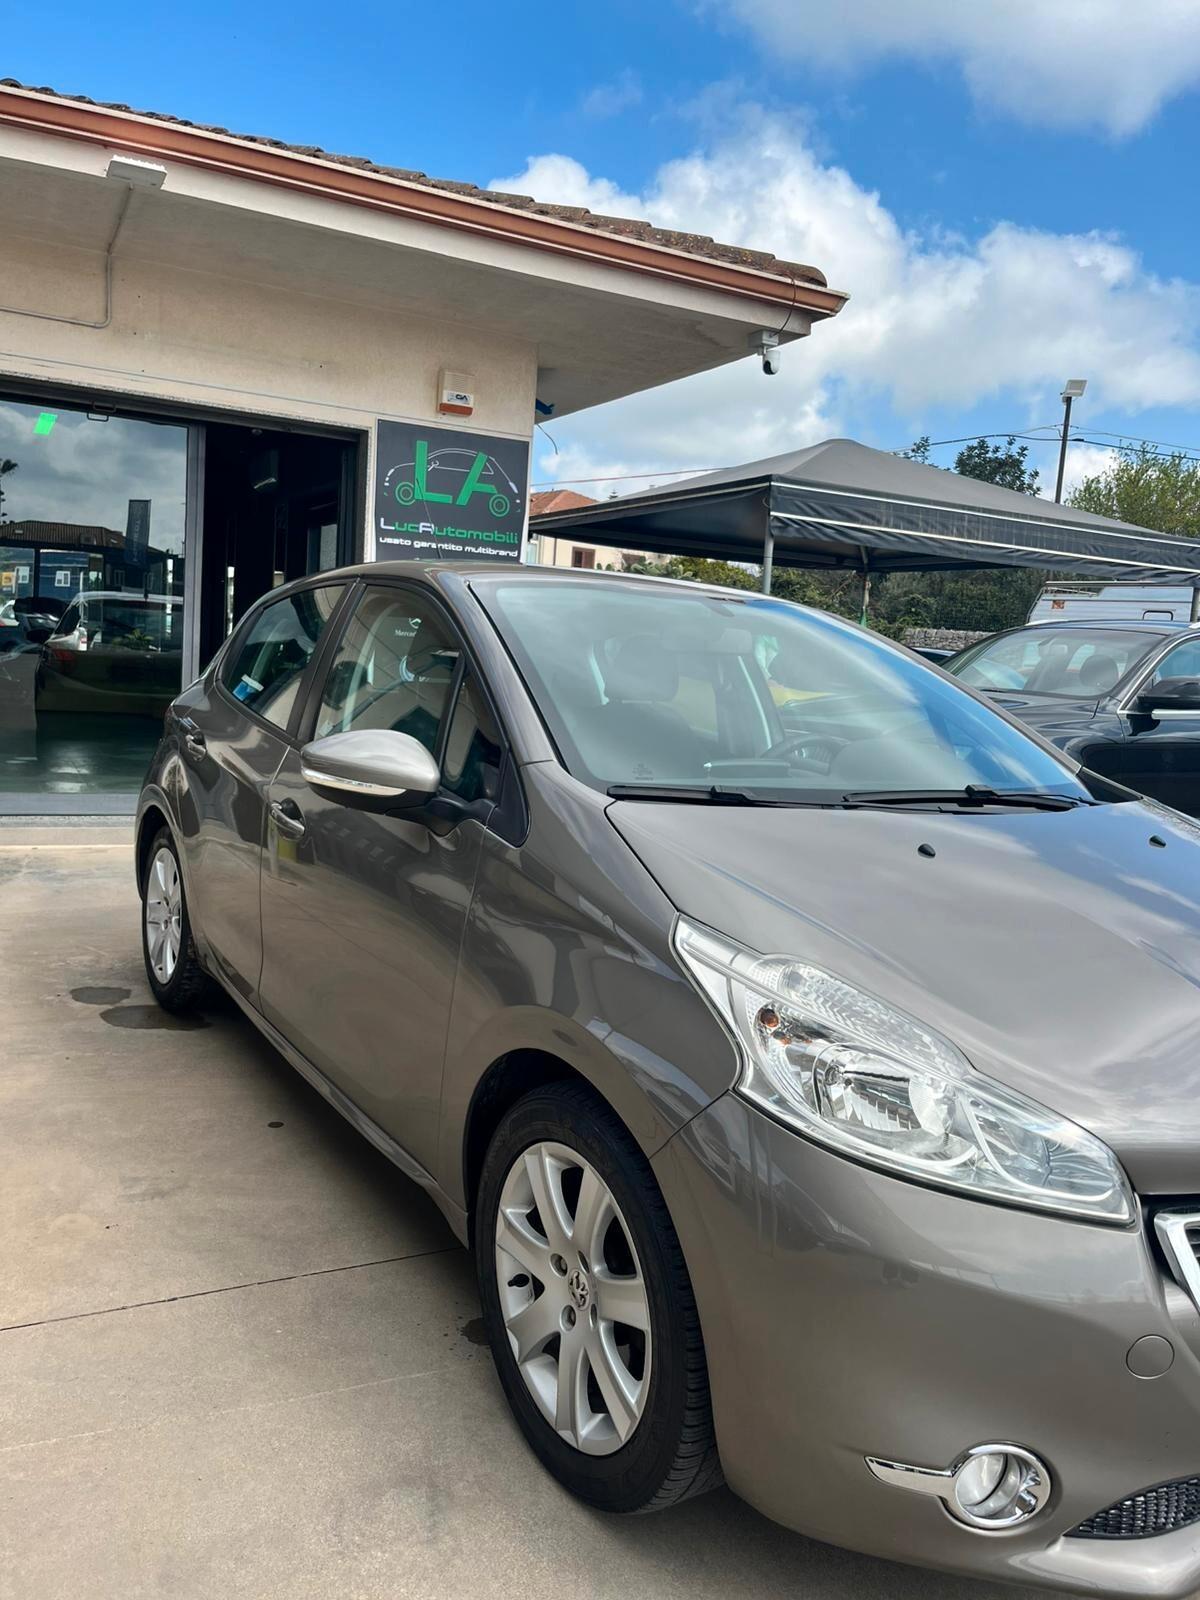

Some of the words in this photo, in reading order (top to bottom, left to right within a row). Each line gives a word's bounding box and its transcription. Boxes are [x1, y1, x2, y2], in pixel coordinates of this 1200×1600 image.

[380, 517, 518, 544] LucAutomobili
[379, 537, 412, 546] usato
[413, 540, 463, 552] garantito
[464, 546, 518, 557] multibrand
